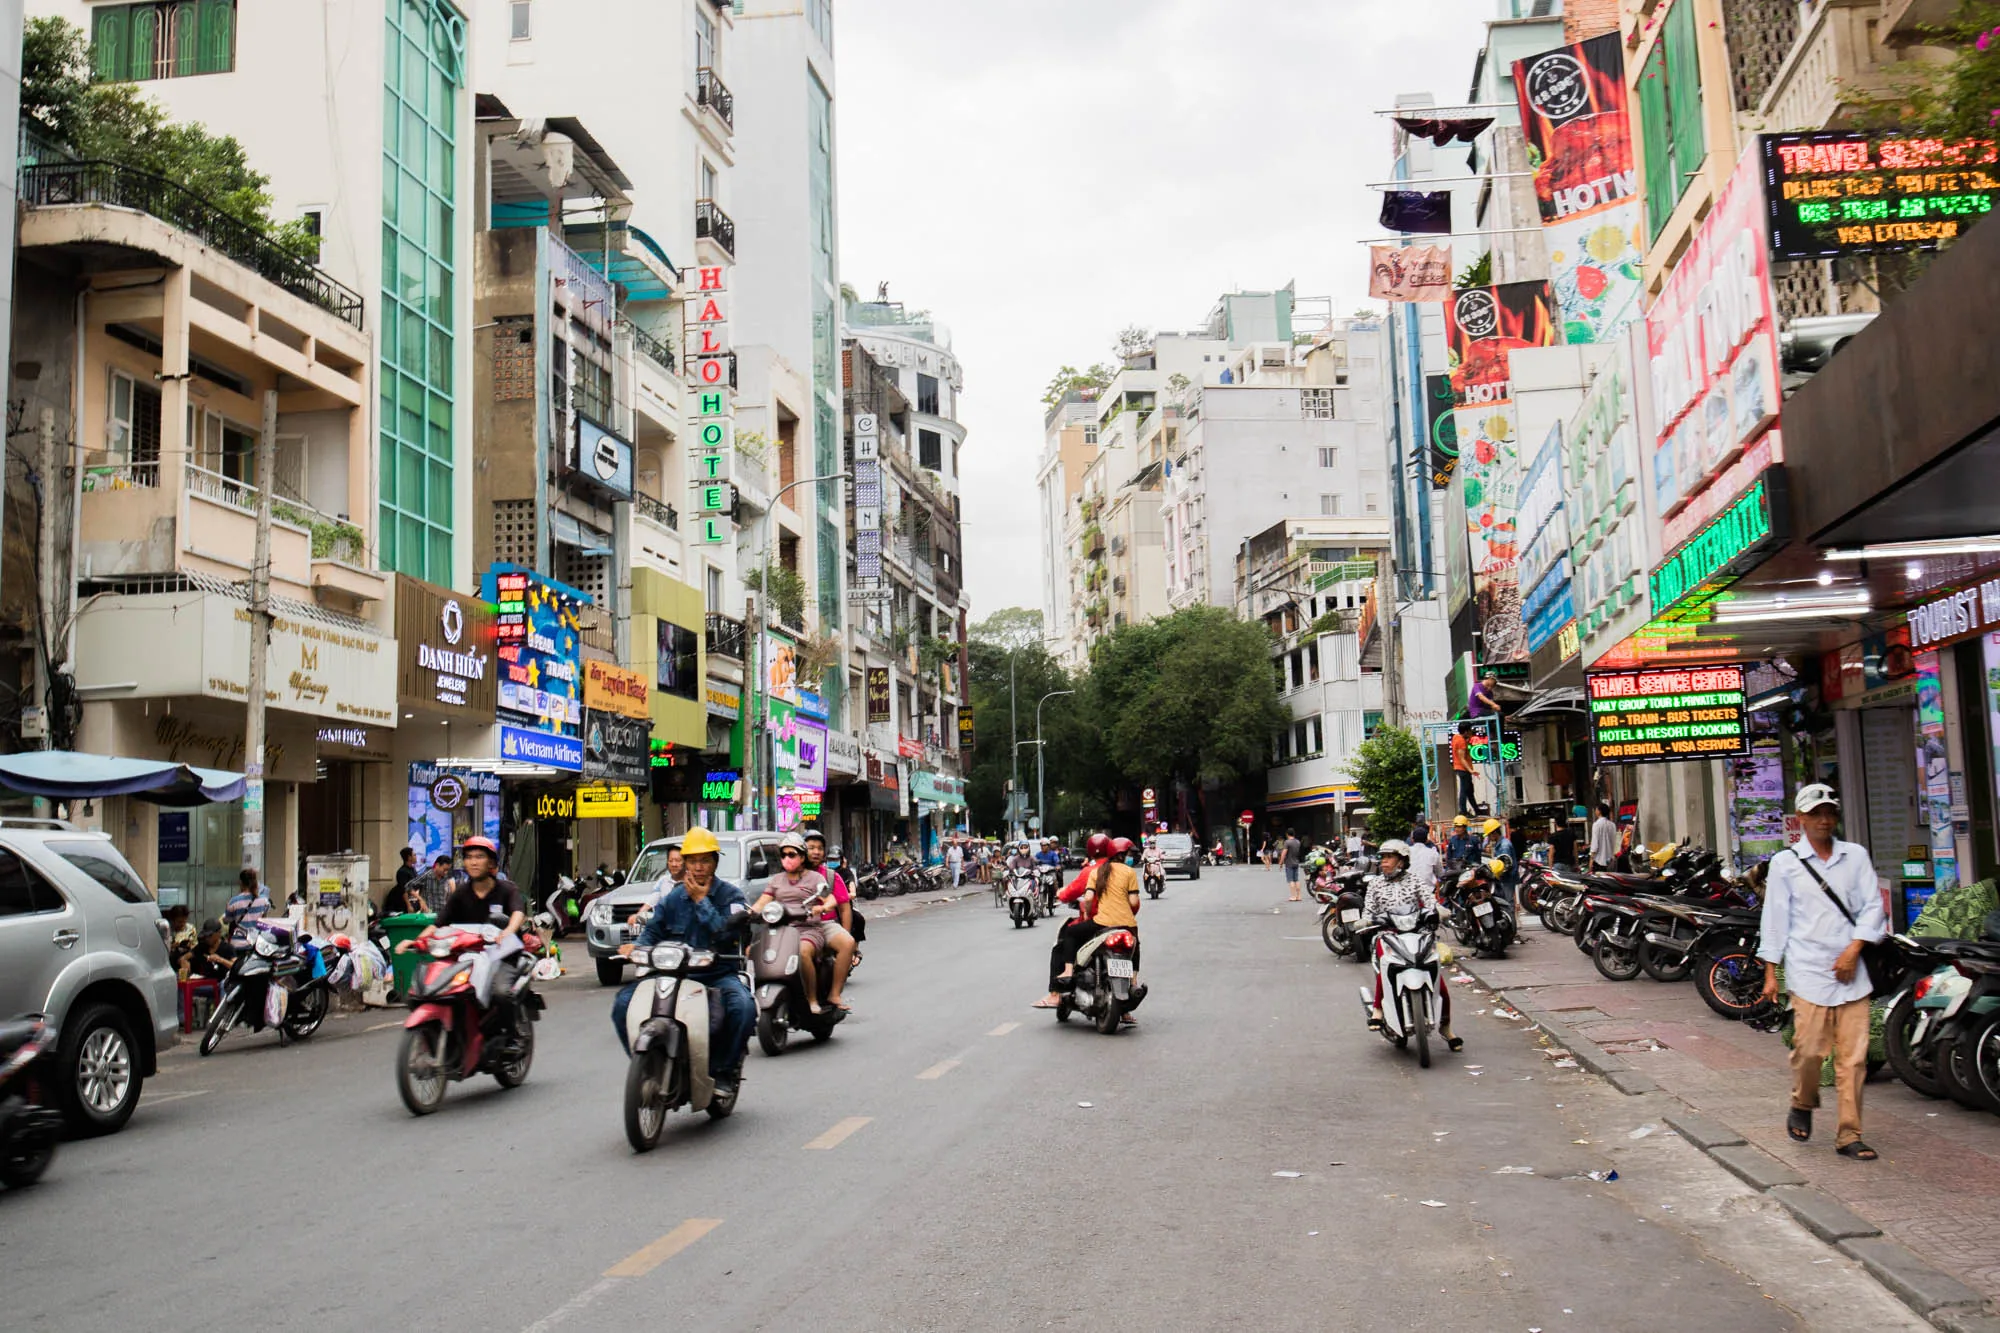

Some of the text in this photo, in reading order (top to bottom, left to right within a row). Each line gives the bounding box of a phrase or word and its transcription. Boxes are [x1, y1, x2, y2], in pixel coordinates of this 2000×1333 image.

[1778, 142, 1876, 174] TRAVEL
[1553, 175, 1612, 218] HOT
[1798, 202, 1831, 222] BUS
[698, 266, 723, 384] HALO
[701, 392, 724, 543] HOTEL
[1906, 587, 1978, 647] TOURIST
[419, 644, 454, 673] DANH
[437, 675, 466, 693] JEWELERS
[1591, 670, 1740, 697] TRAVEL SERVICE CENTER
[1592, 693, 1742, 712] DAILY GROUP TOUR & PRIVATE TOUR
[1599, 716, 1618, 727] AIR
[1626, 713, 1659, 725] TRAIN
[1667, 711, 1690, 723] BUS
[1691, 709, 1738, 721] TICKETS
[1599, 724, 1740, 741] HOTEL & RESORT BOOKING
[519, 736, 581, 764] Vietnam Airlines
[1601, 745, 1623, 757] CAR
[1624, 743, 1664, 756] RENTAL
[1672, 741, 1696, 753] VISA
[1697, 739, 1740, 751] SERVICE
[412, 763, 438, 784] Tourist
[479, 773, 500, 792] Center
[537, 794, 555, 818] LỘC
[557, 796, 574, 817] QUÝ
